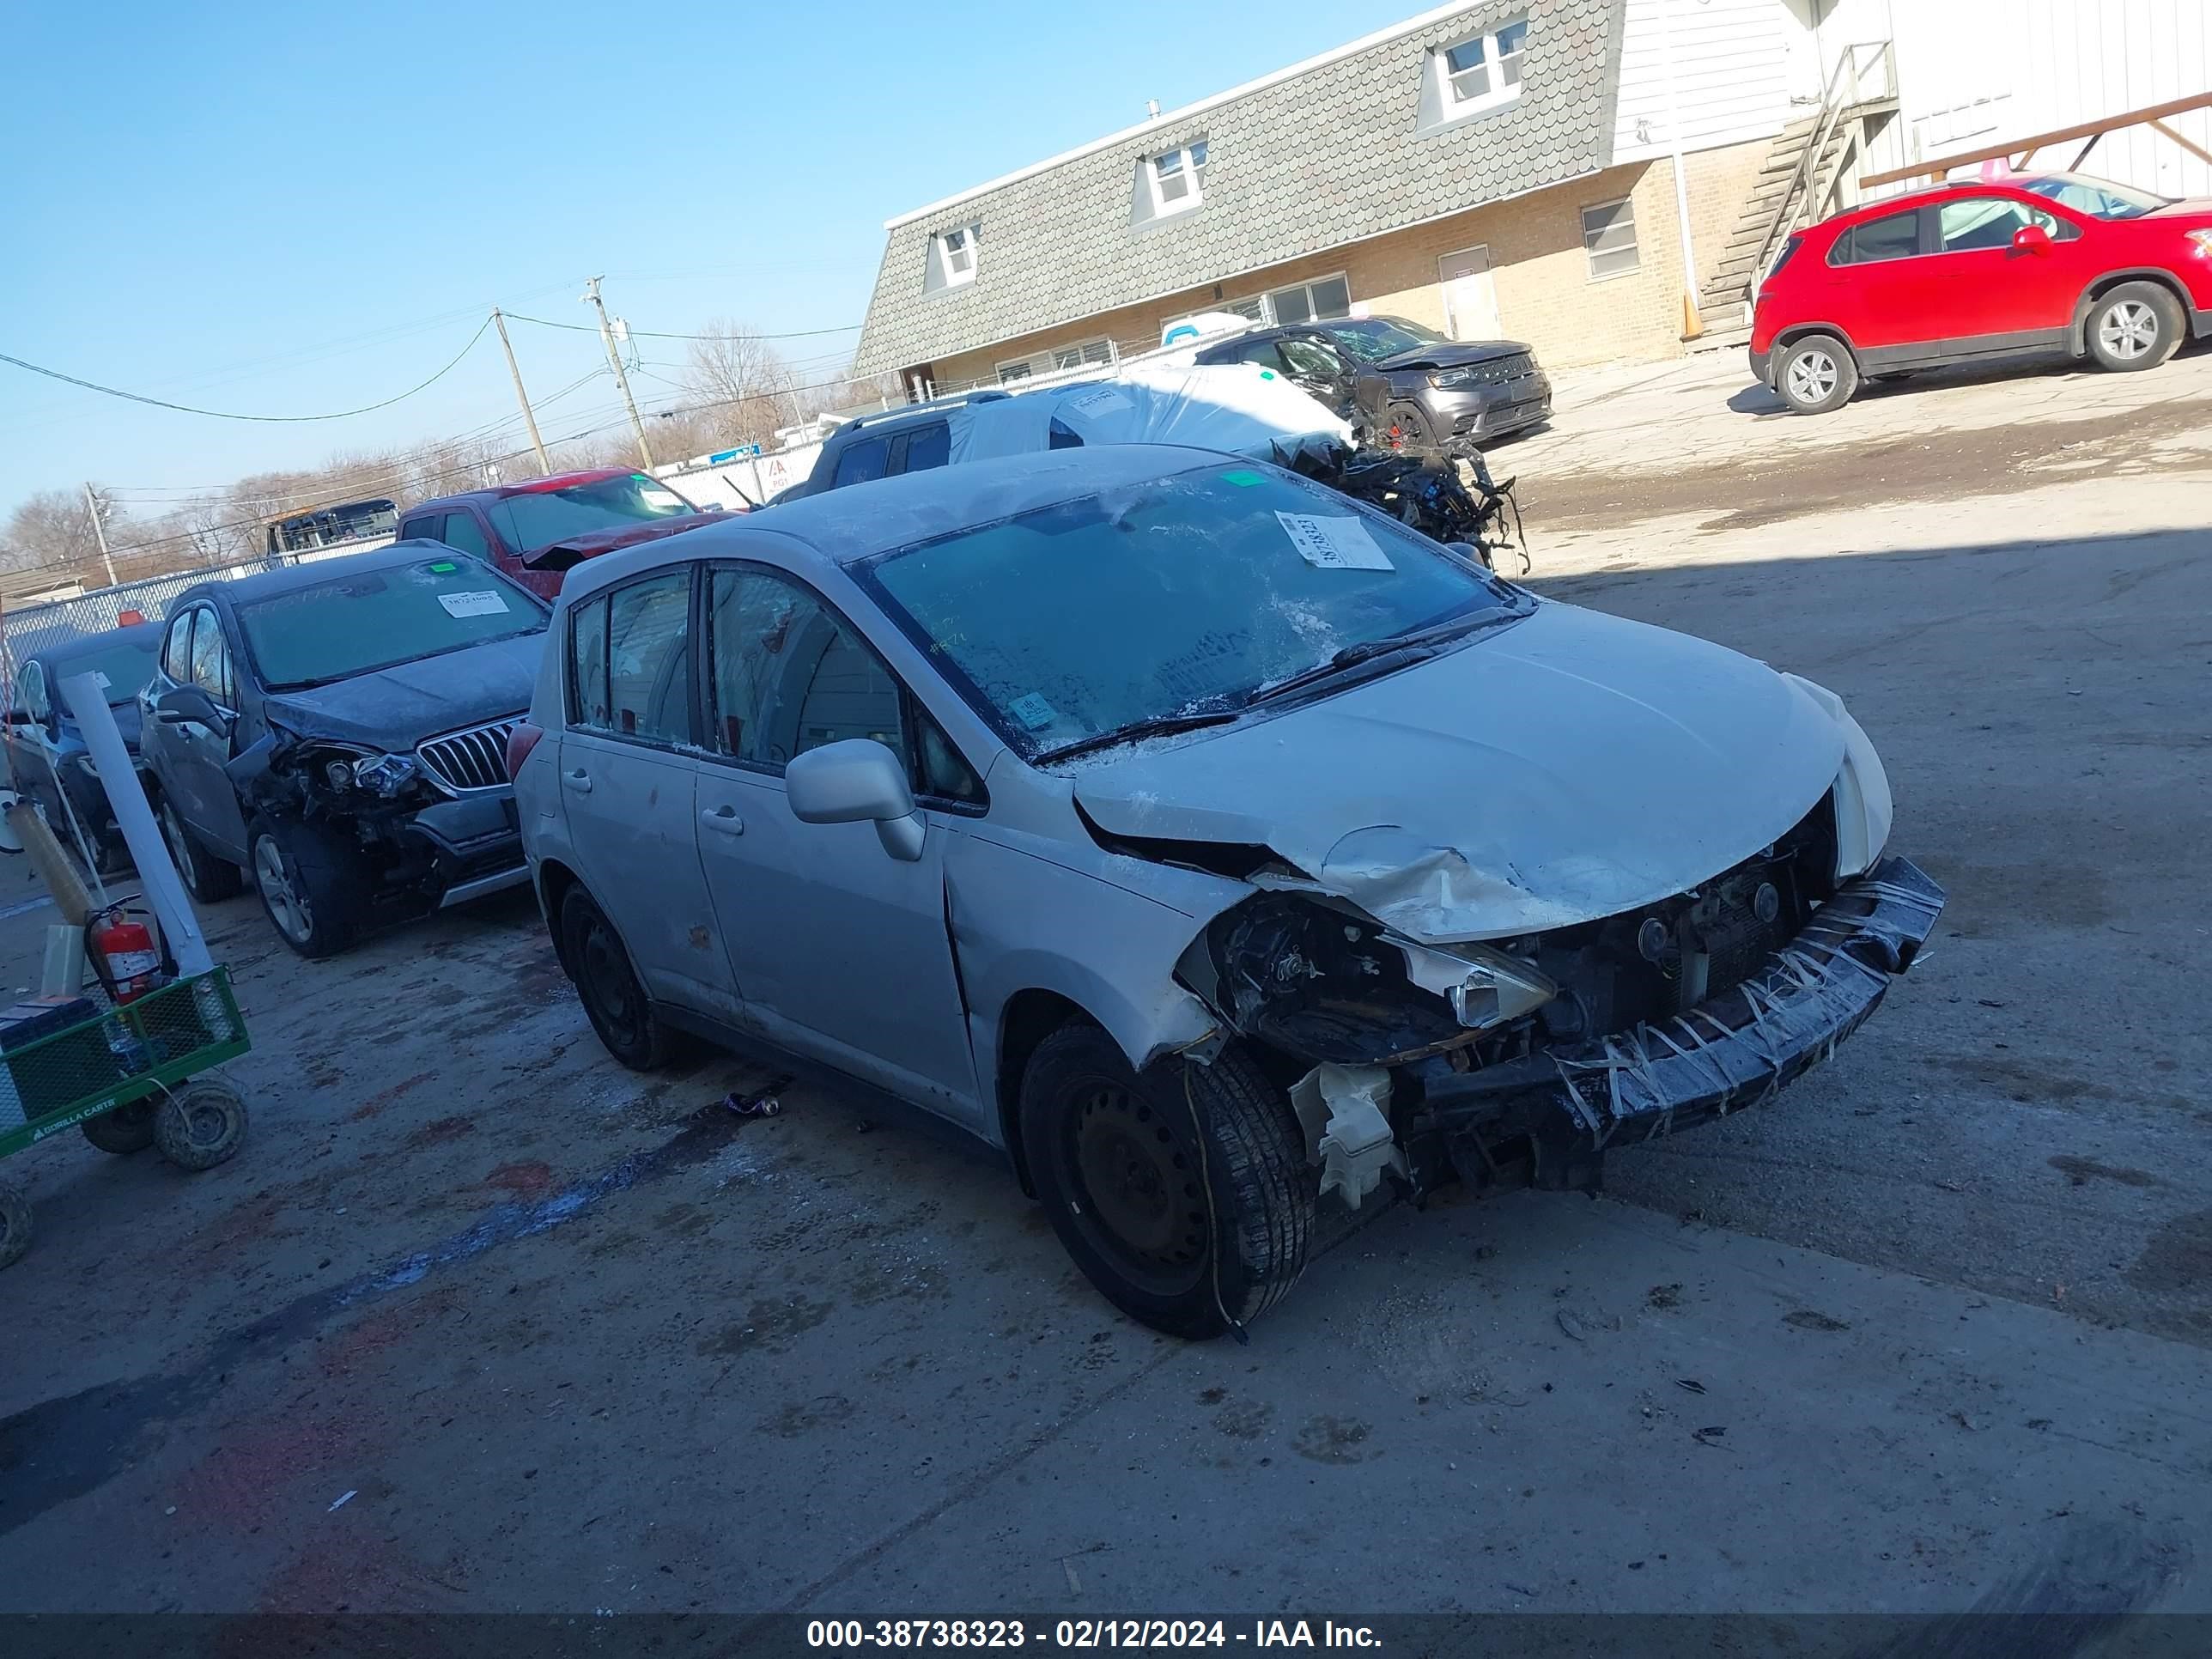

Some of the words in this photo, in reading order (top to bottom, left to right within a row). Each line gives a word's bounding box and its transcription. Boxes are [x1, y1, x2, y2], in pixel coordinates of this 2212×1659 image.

[1297, 520, 1341, 563] 38738323
[44, 1113, 83, 1134] GORILLA
[83, 1098, 116, 1117] CARTS
